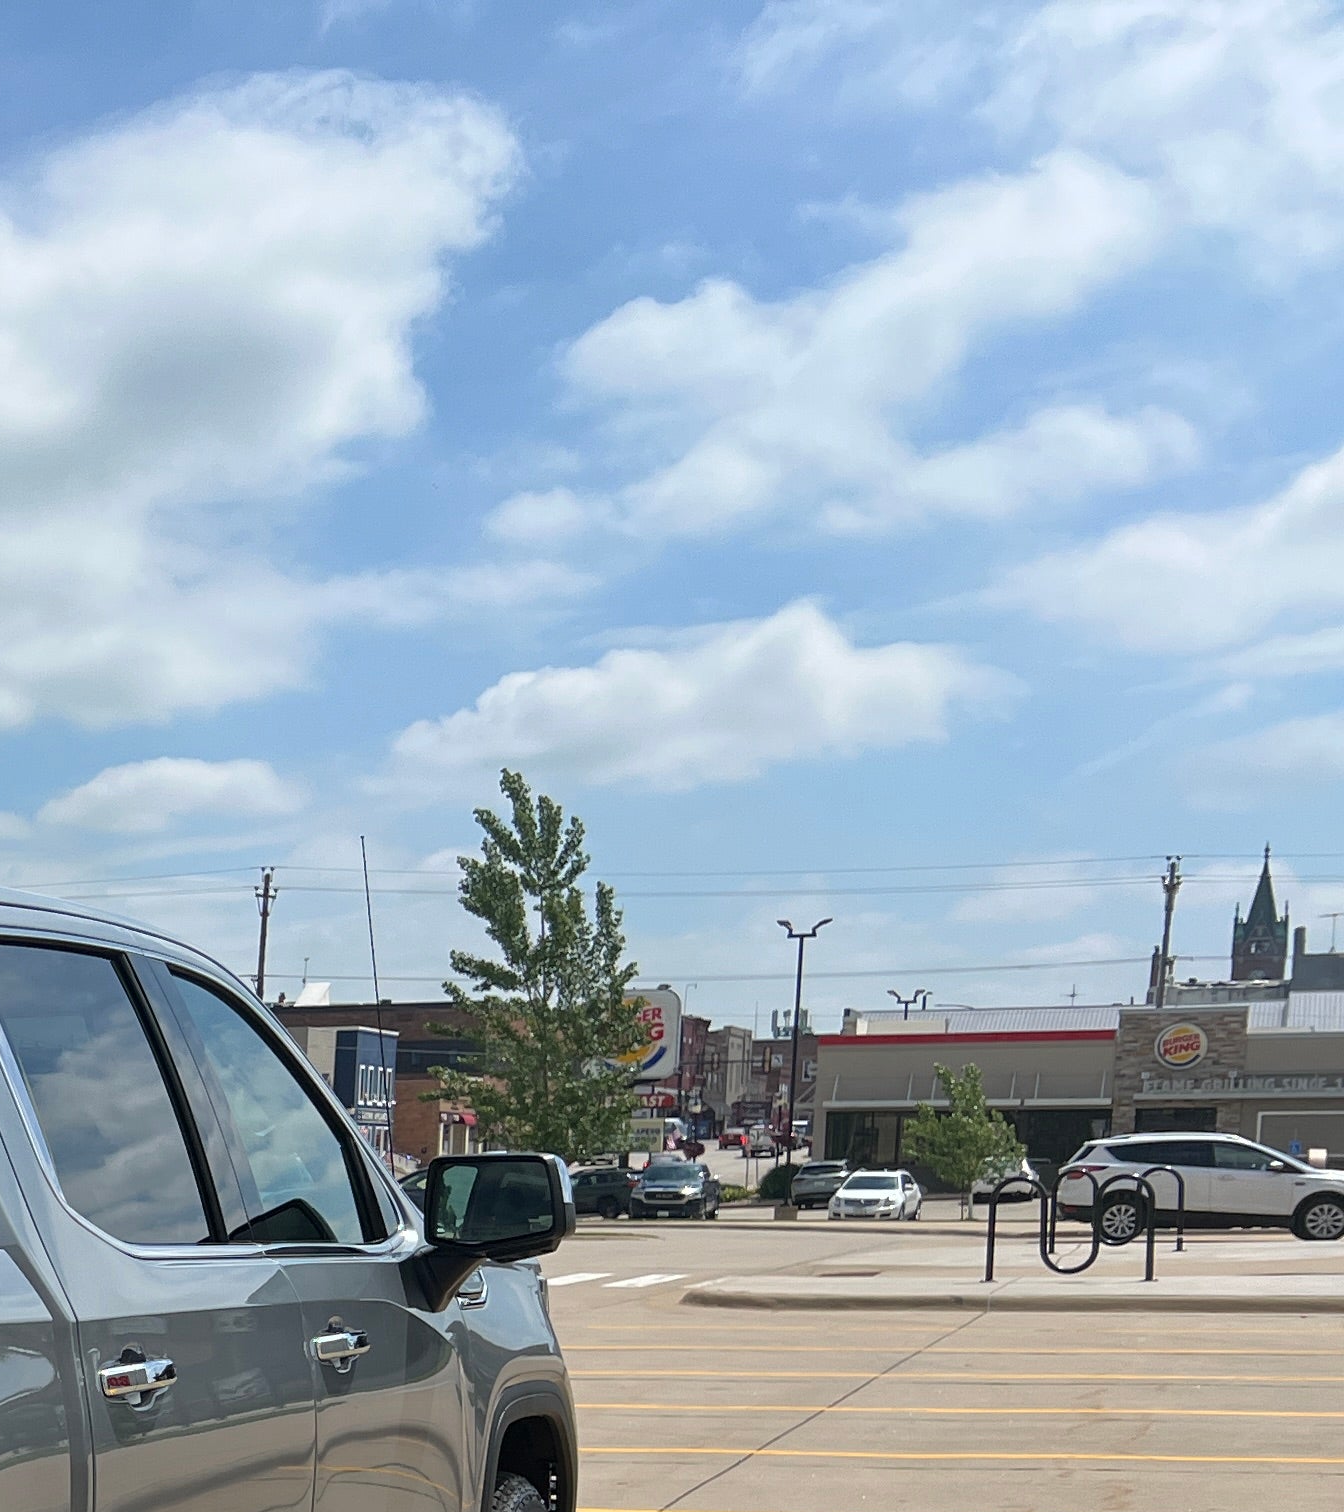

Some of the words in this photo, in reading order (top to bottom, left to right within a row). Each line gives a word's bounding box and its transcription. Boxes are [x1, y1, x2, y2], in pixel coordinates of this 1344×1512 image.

[1162, 1033, 1200, 1049] BURGER
[1162, 1041, 1201, 1057] KING
[1142, 1079, 1195, 1094] FLAME
